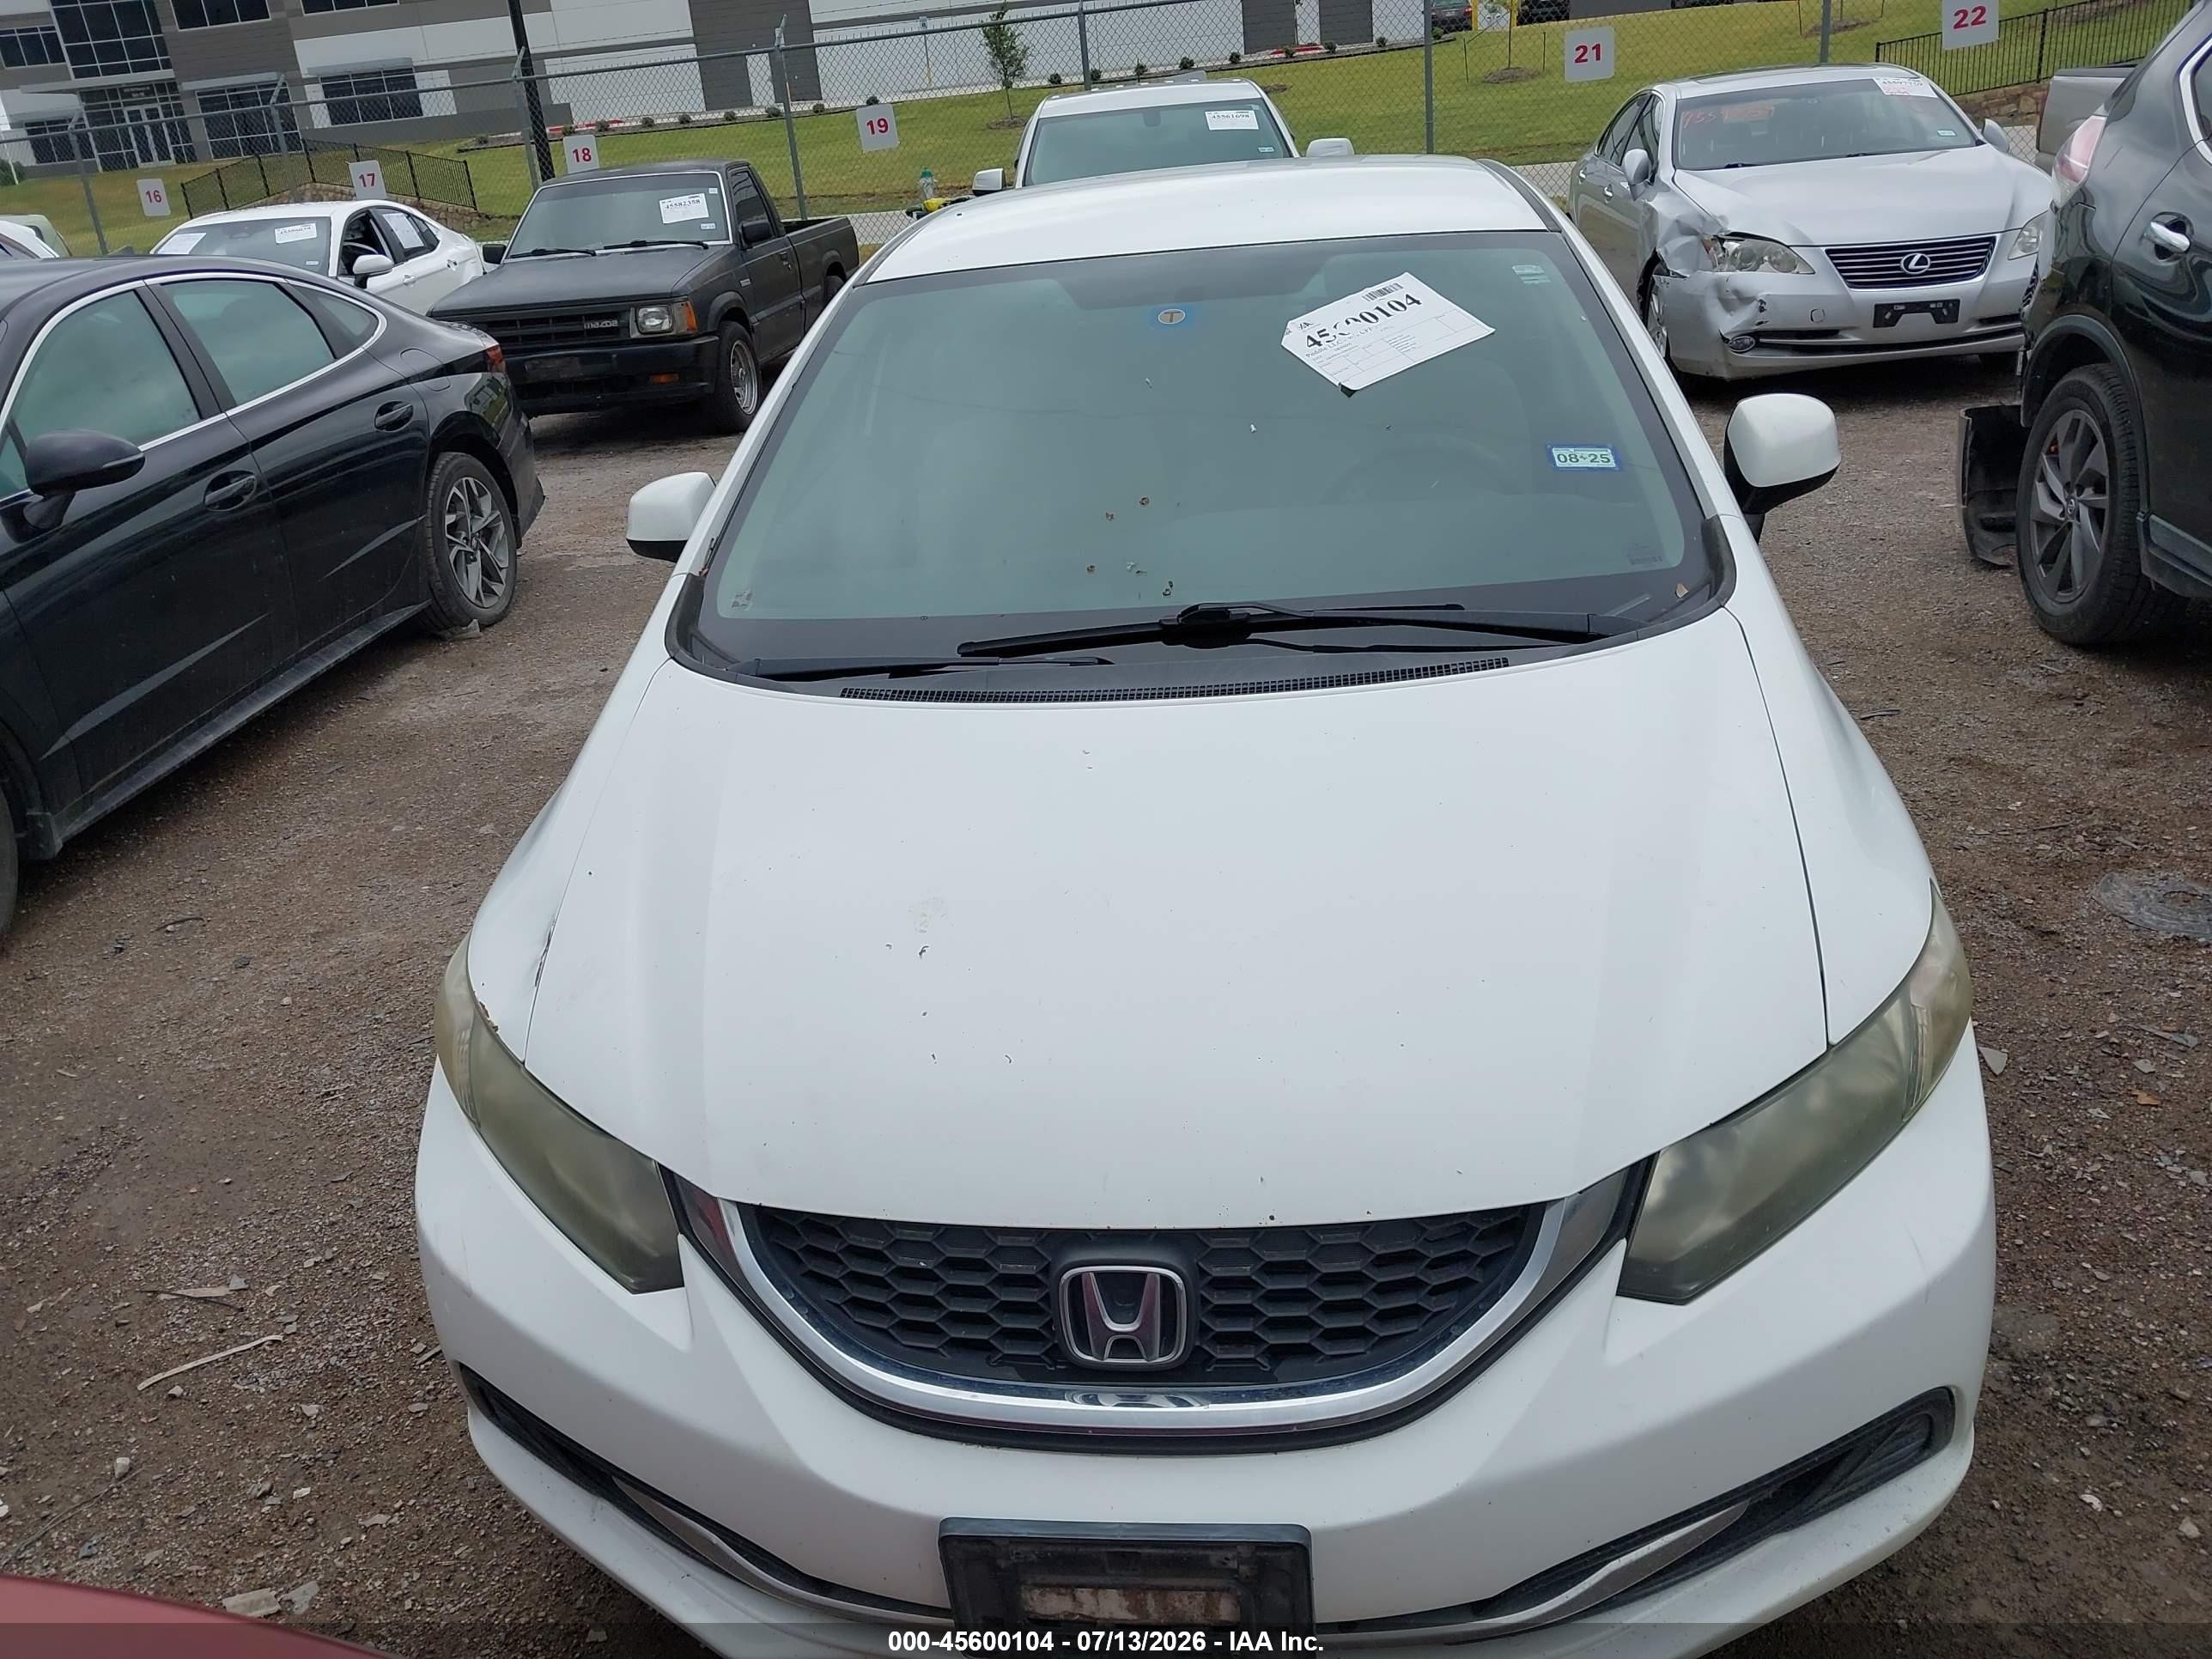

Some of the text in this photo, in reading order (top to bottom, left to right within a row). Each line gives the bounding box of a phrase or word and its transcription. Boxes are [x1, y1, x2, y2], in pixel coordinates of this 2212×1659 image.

[1954, 5, 1986, 29] 22
[1574, 43, 1601, 64] 21
[866, 118, 889, 135] 19
[572, 147, 592, 163] 18
[358, 173, 375, 187] 17
[145, 189, 162, 204] 16
[1557, 453, 1611, 464] 08 25
